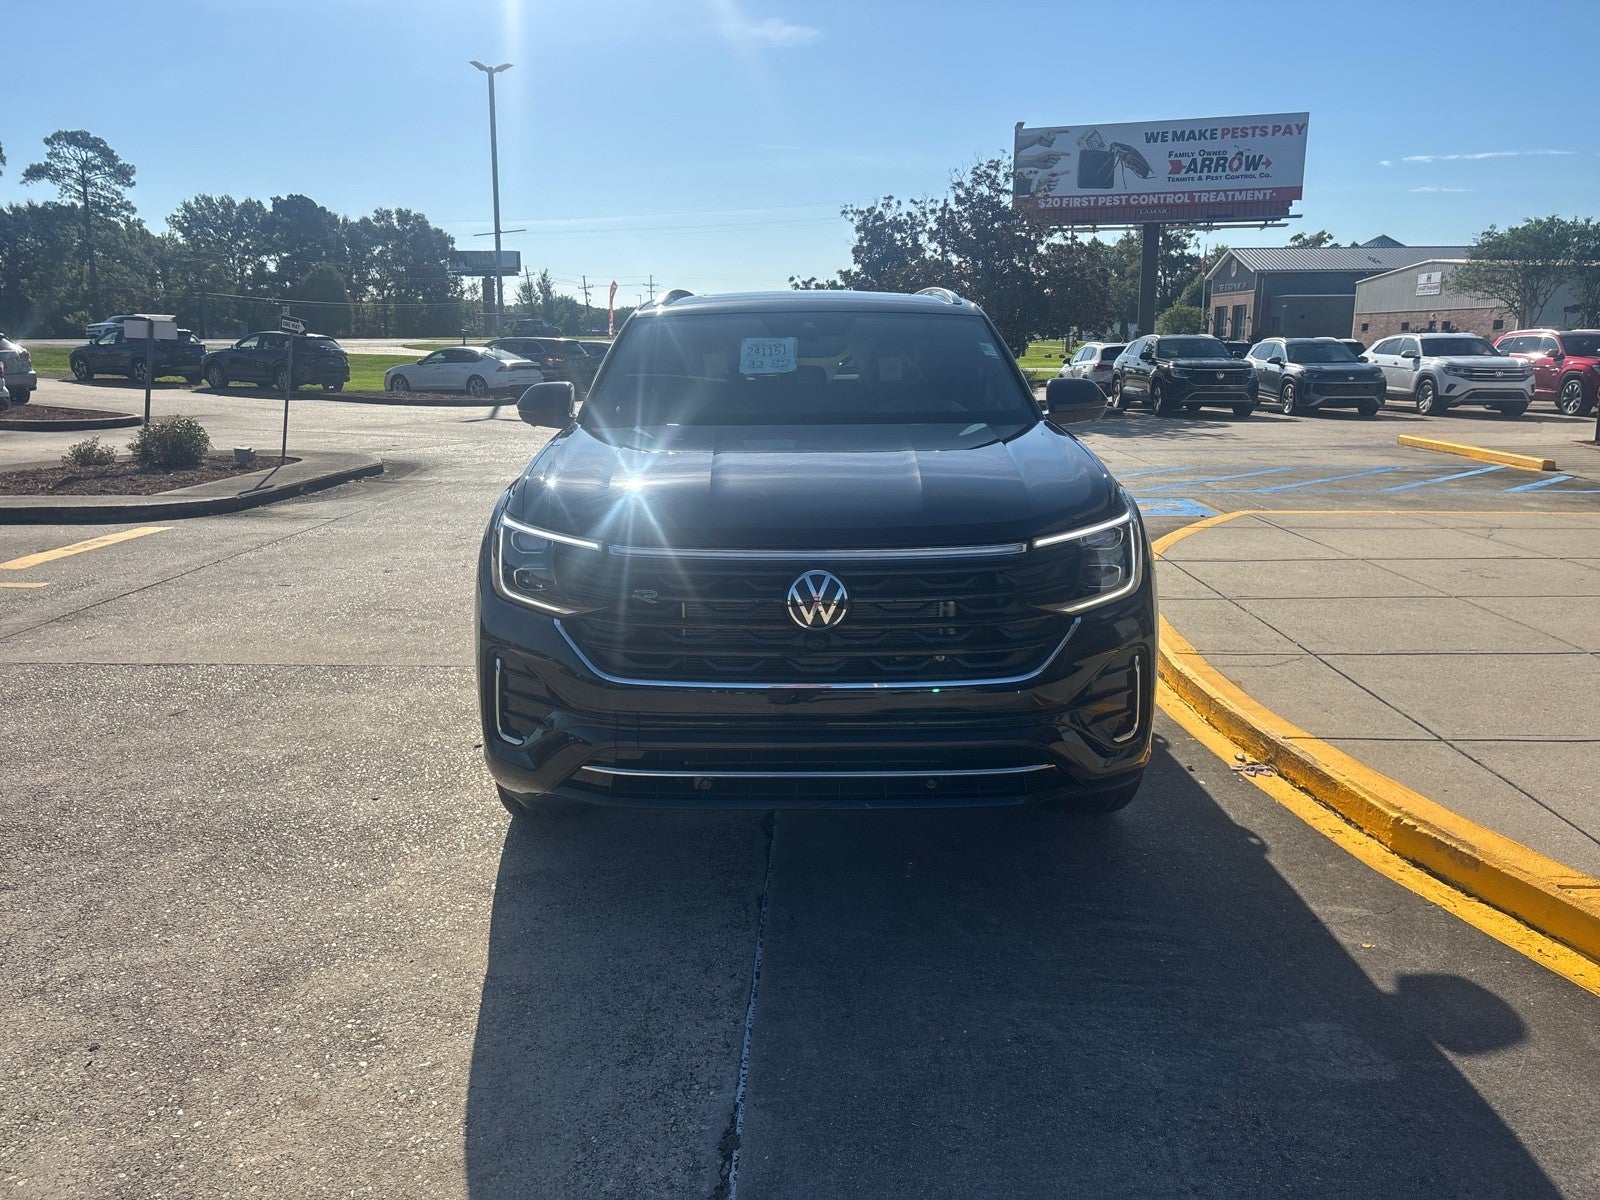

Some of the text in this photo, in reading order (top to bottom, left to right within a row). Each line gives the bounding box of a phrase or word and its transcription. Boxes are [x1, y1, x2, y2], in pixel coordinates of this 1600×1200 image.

[1144, 122, 1307, 143] WE MAKE PESTS PAY
[1198, 149, 1228, 157] OWNED
[1184, 152, 1264, 174] ARROW
[1038, 197, 1060, 209] $20
[1062, 196, 1096, 207] FIRST
[1098, 195, 1128, 206] PEST
[1129, 193, 1190, 205] CONTROL
